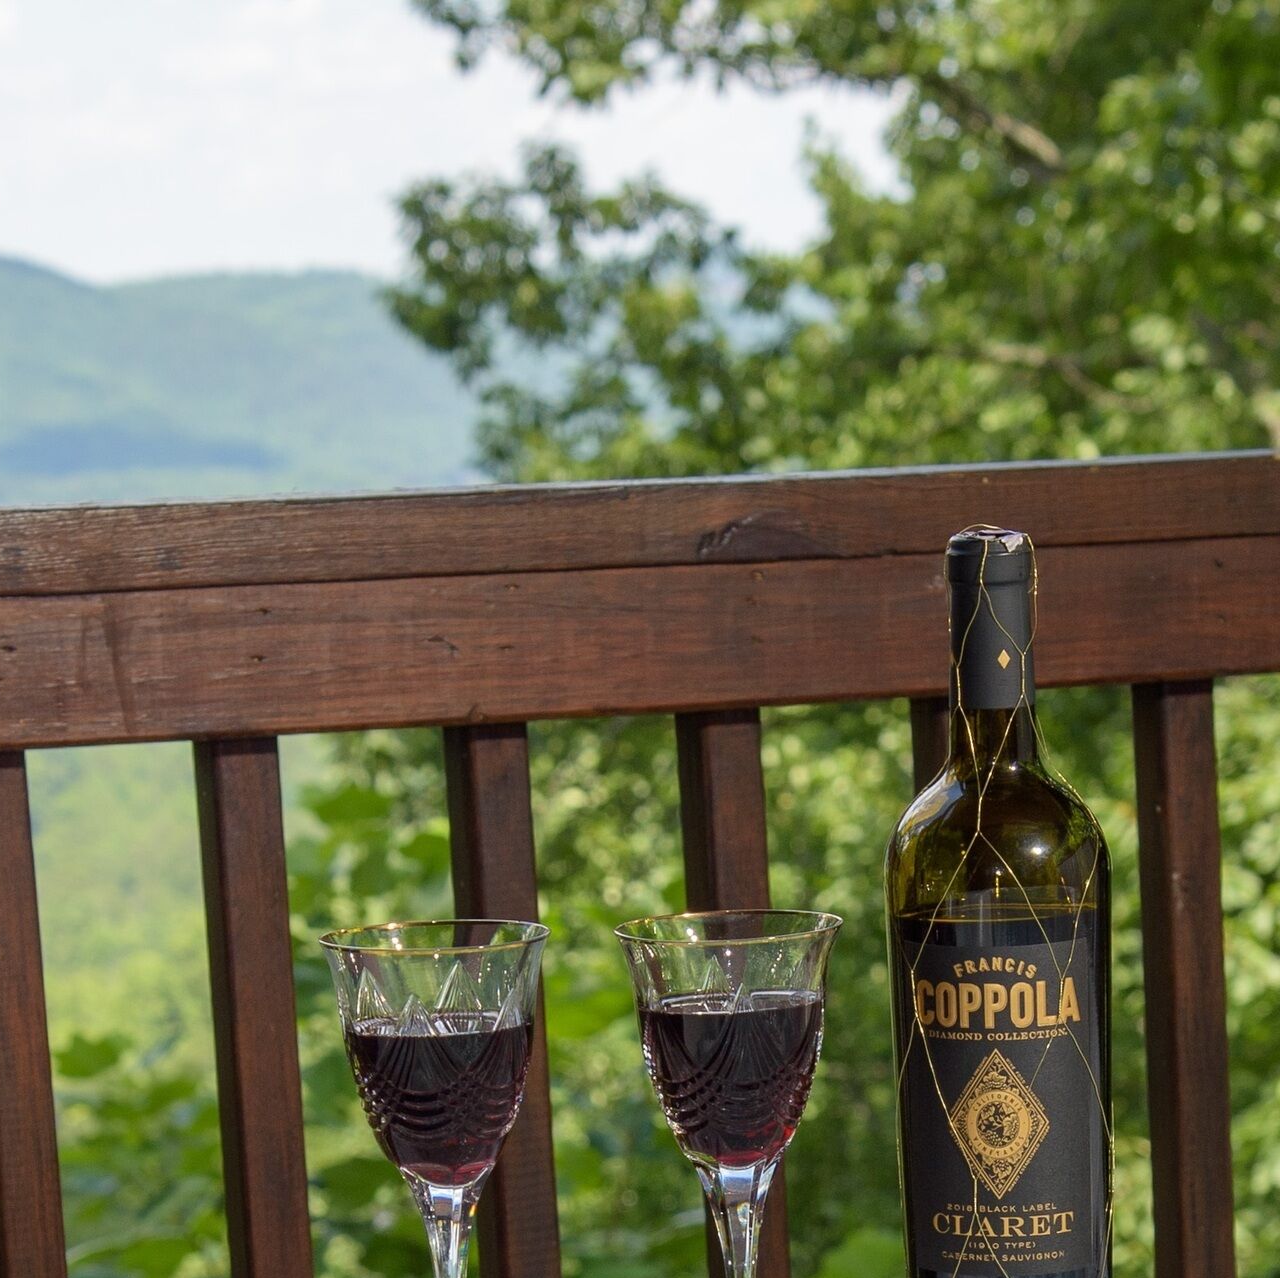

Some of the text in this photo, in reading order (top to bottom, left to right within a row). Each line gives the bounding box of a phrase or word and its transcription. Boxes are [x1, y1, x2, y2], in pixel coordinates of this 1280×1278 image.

[953, 956, 1038, 979] FRANCIS
[916, 976, 1081, 1029] COPPOLA
[928, 1030, 983, 1041] DIAMOND
[979, 1205, 1017, 1213] BLACK
[1022, 1202, 1057, 1213] LABEL
[932, 1211, 1074, 1238] CLARET
[1004, 1241, 1036, 1249] TYPE)
[942, 1250, 1065, 1262] CABERNET SAUVIGNON
